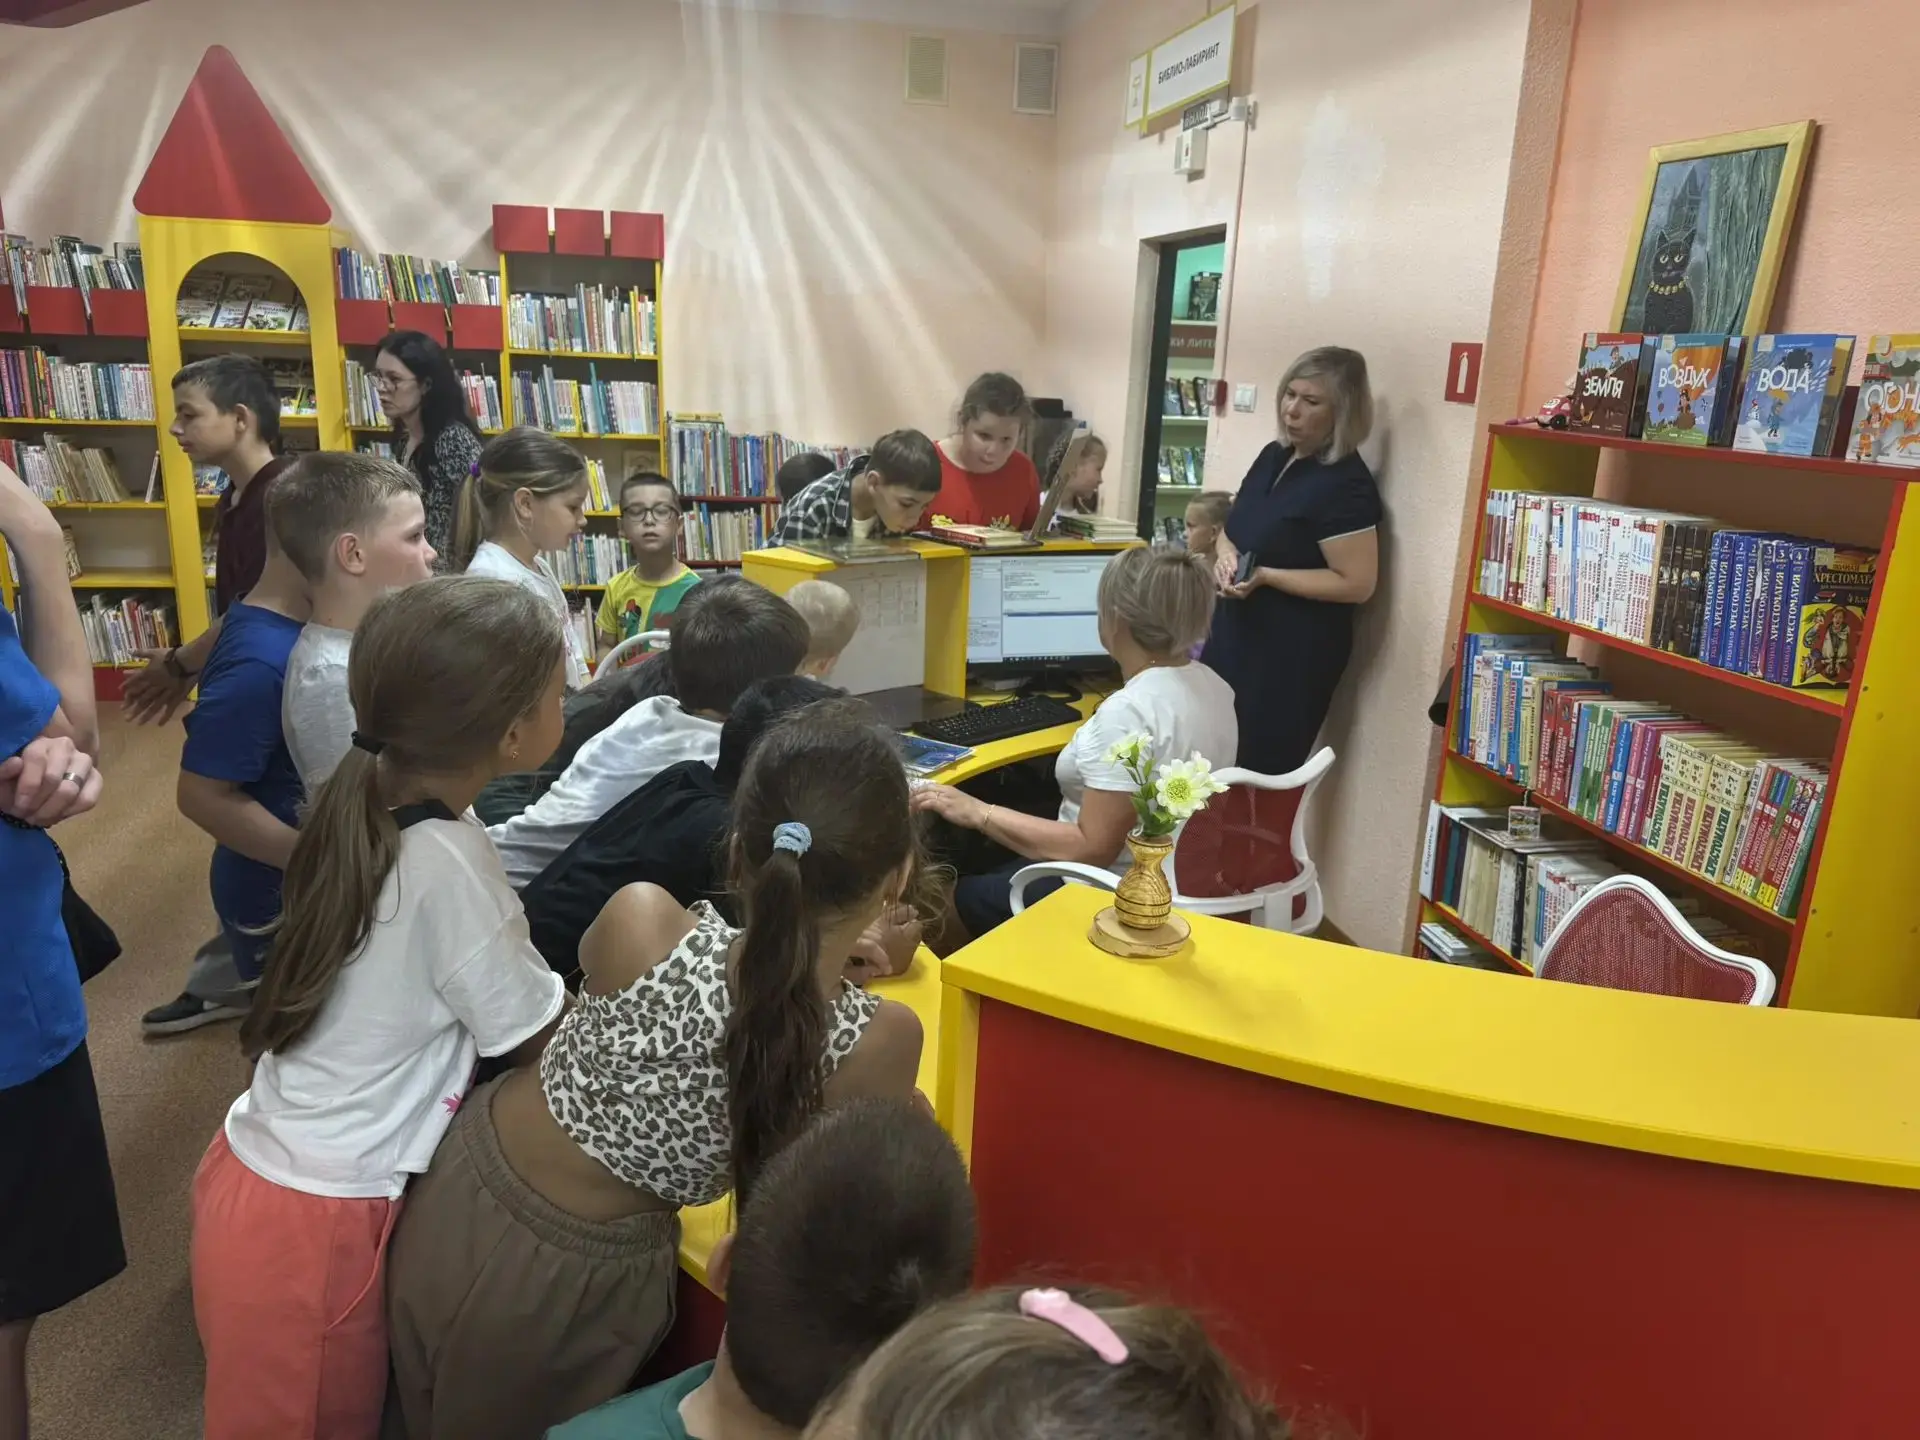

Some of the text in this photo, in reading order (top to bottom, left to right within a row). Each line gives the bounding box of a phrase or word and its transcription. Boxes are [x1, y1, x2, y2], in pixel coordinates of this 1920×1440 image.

[1158, 42, 1220, 84] БИБЛИО-ЛАБИРИНТ
[1583, 376, 1624, 399] ЗЕМЛЯ
[1658, 363, 1711, 390] ВОЗДУХ
[1756, 366, 1810, 394] ВОДА
[1703, 558, 1718, 621] ХРЕСТОМАТИЯ
[1713, 560, 1728, 627] ХРЕСТОМАТИЯ
[1729, 562, 1744, 629] ХРЕСТОМАТИЯ
[1741, 564, 1755, 630] ХРЕСТОМАТИЯ
[1755, 567, 1771, 636] ХРЕСТОМАТИЯ
[1770, 570, 1784, 640] ХРЕСТОМАТИЯ
[1785, 573, 1801, 643] ХРЕСТОМАТИЯ
[1664, 750, 1673, 771] 5-7
[1725, 775, 1735, 796] 5-7
[1647, 781, 1670, 849] ХРЕСТОМАТИЯ
[1662, 790, 1684, 856] ХРЕСТОМАТИЯ
[1673, 796, 1696, 863] ХРЕСТОМАТИЯ
[1691, 803, 1715, 871] ХРЕСТОМАТИЯ
[1705, 806, 1730, 877] ХРЕСТОМАТИЯ
[1774, 834, 1795, 884] ХРЕСТОМАТИЯ
